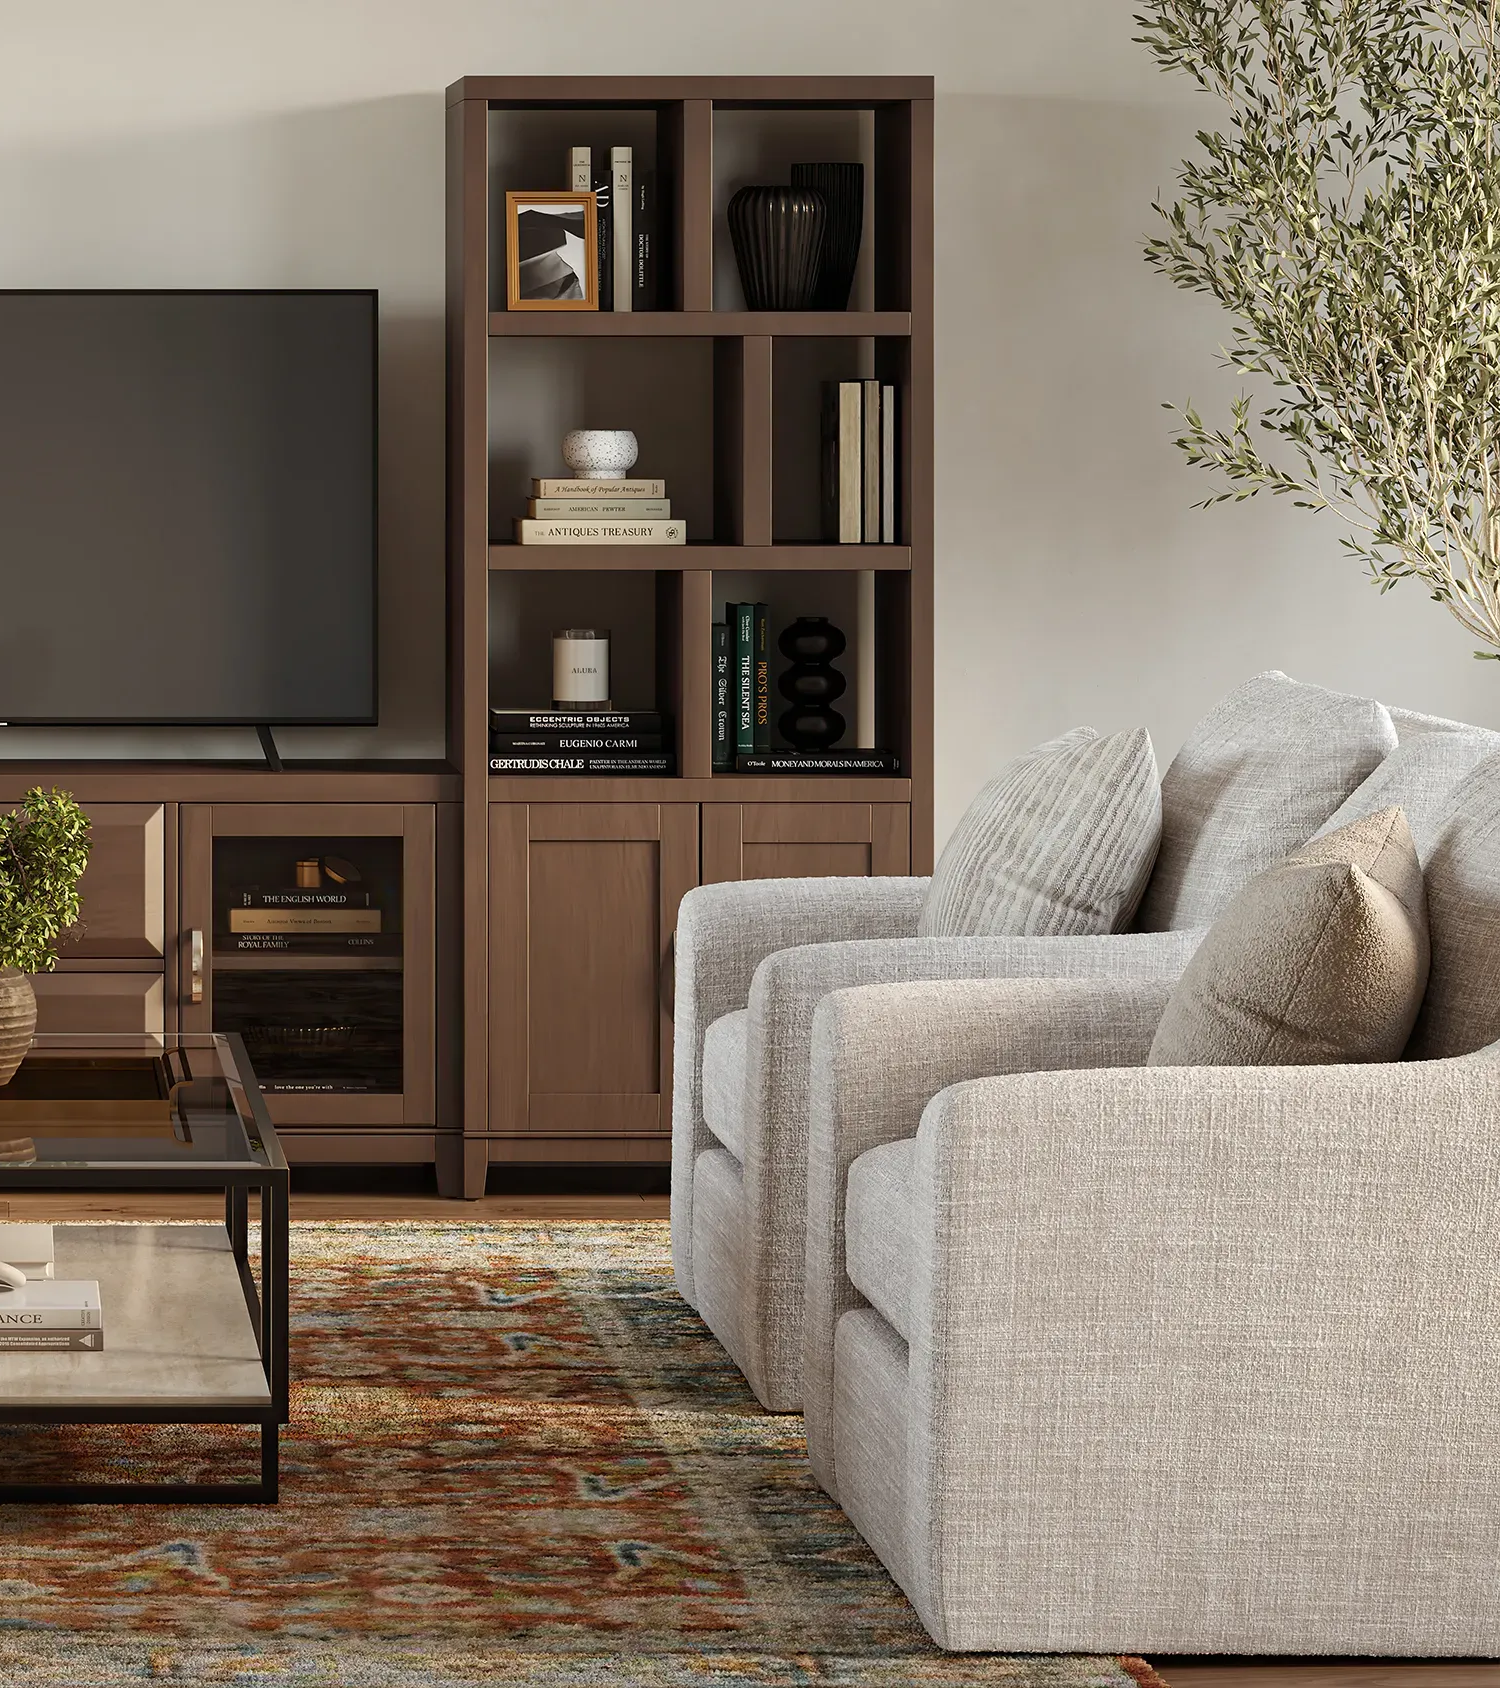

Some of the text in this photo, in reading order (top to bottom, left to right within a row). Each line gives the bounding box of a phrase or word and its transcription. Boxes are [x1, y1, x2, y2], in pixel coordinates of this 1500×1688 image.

[578, 174, 586, 182] N
[620, 174, 627, 182] N
[599, 486, 620, 494] Popular
[621, 486, 645, 494] Antiques
[548, 528, 599, 537] ANTIQUES
[601, 528, 653, 536] TREASURY
[758, 662, 767, 725] PRO'S PROS
[560, 739, 637, 748] EUGENIO CARMI
[490, 759, 584, 769] GERTRUDIS CHALE
[771, 760, 798, 768] MONEY
[798, 760, 814, 768] AND
[814, 760, 844, 768] MORALS
[852, 760, 883, 768] AMERICA
[262, 895, 347, 903] THE ENGLISH WORLD
